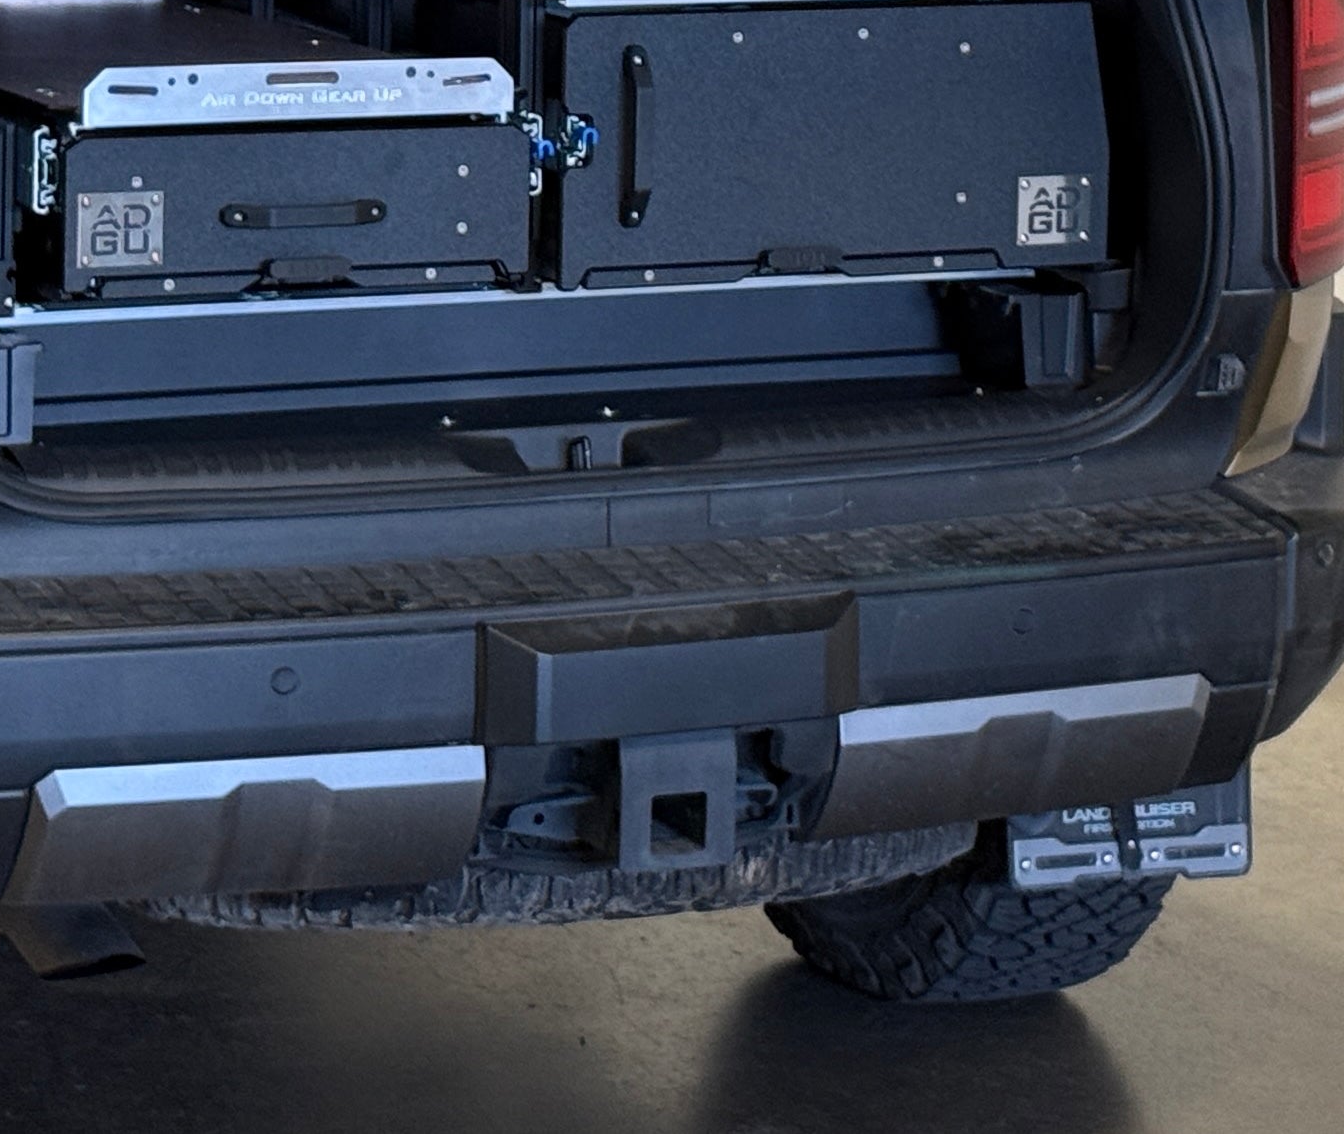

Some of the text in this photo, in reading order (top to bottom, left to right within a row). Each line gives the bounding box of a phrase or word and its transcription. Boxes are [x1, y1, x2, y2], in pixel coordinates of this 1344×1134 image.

[1062, 801, 1196, 824] LAND UISER
[1083, 822, 1114, 835] FIRS
